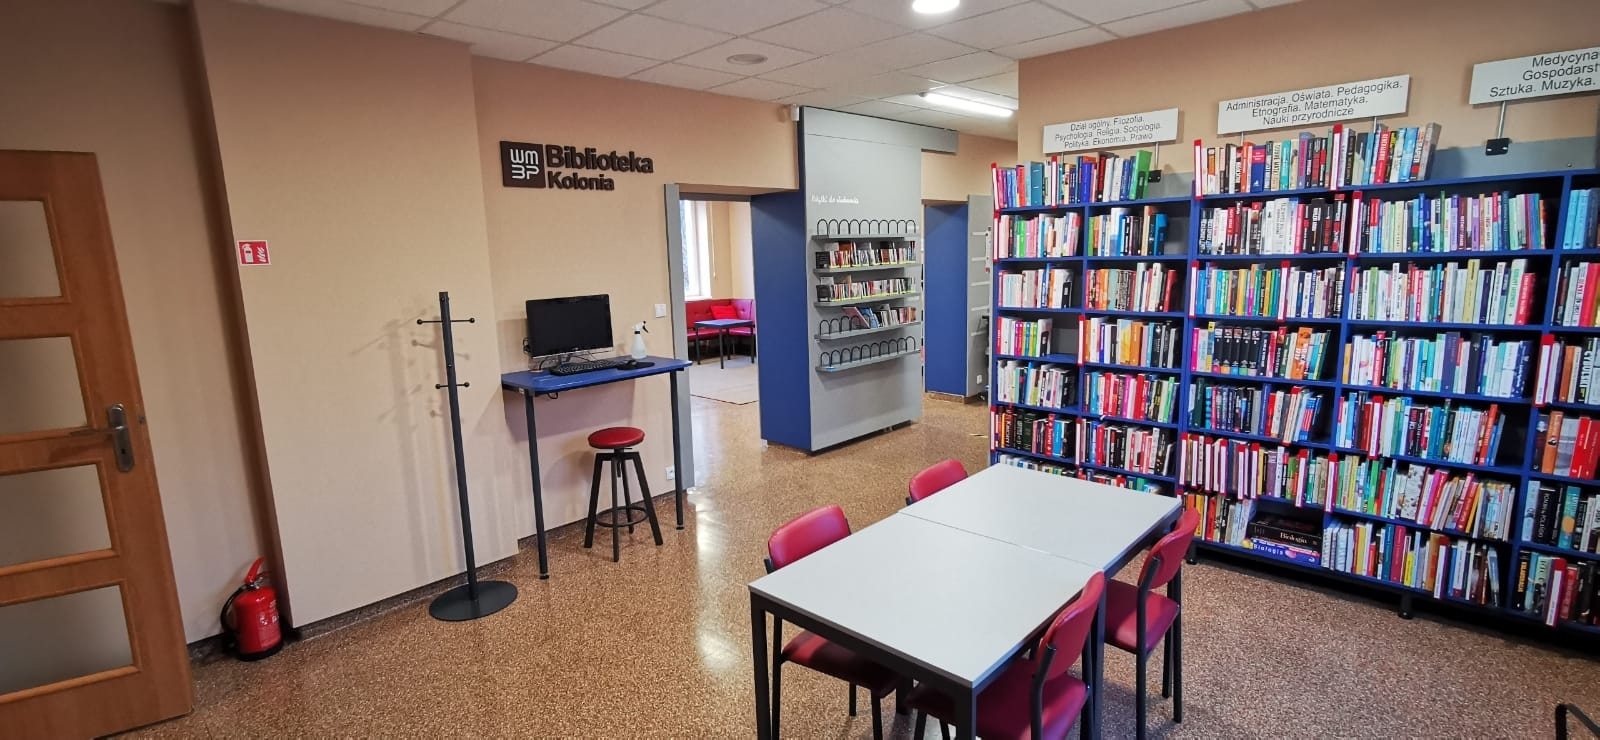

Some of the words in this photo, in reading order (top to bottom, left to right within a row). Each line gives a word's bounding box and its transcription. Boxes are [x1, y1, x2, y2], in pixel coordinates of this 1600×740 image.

[1226, 98, 1289, 112] Administracja.
[1292, 91, 1333, 103] Oświata.
[1337, 80, 1403, 97] Pedagogika.
[1489, 83, 1537, 98] Sztuka.
[1541, 77, 1596, 92] Muzyka.
[1252, 105, 1300, 118] Etnografia.
[1304, 95, 1368, 111] Matematyka.
[1263, 115, 1290, 126] Nauki
[1291, 108, 1354, 123] przyrodnicze
[545, 145, 653, 173] Biblioteka
[547, 170, 615, 191] Kolonia
